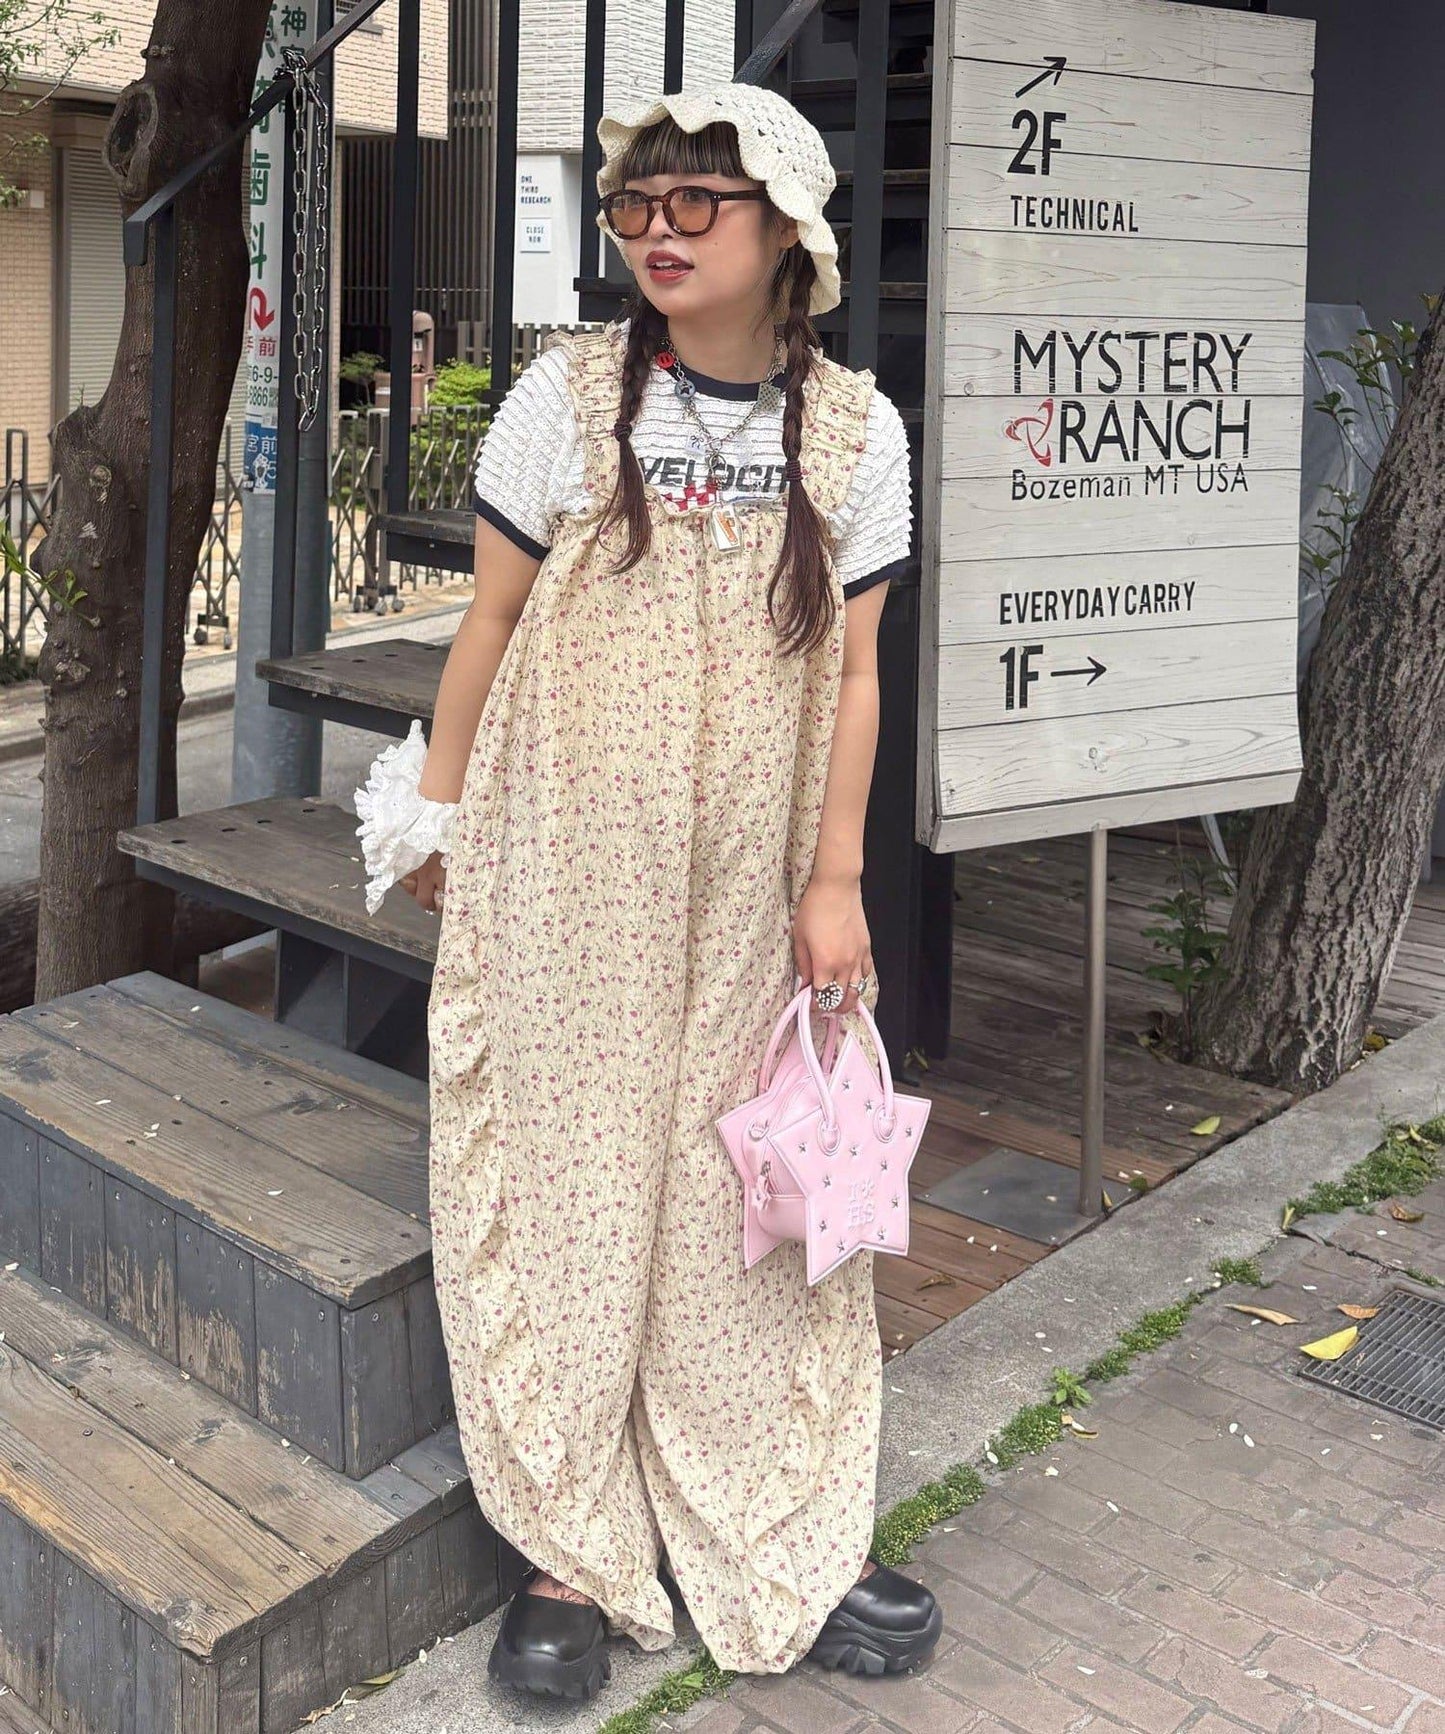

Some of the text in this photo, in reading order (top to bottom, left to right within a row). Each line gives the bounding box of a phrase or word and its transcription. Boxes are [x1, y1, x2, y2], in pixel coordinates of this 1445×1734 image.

[1007, 109, 1067, 176] 2F
[521, 186, 538, 194] THIRD
[521, 196, 551, 204] RESEARCH
[1010, 195, 1139, 232] TECHNICAL
[1013, 329, 1253, 394] MYSTERY
[1058, 398, 1252, 463] RANCH
[1011, 462, 1249, 501] Bozeman MT USA
[1000, 644, 1044, 711] 1F
